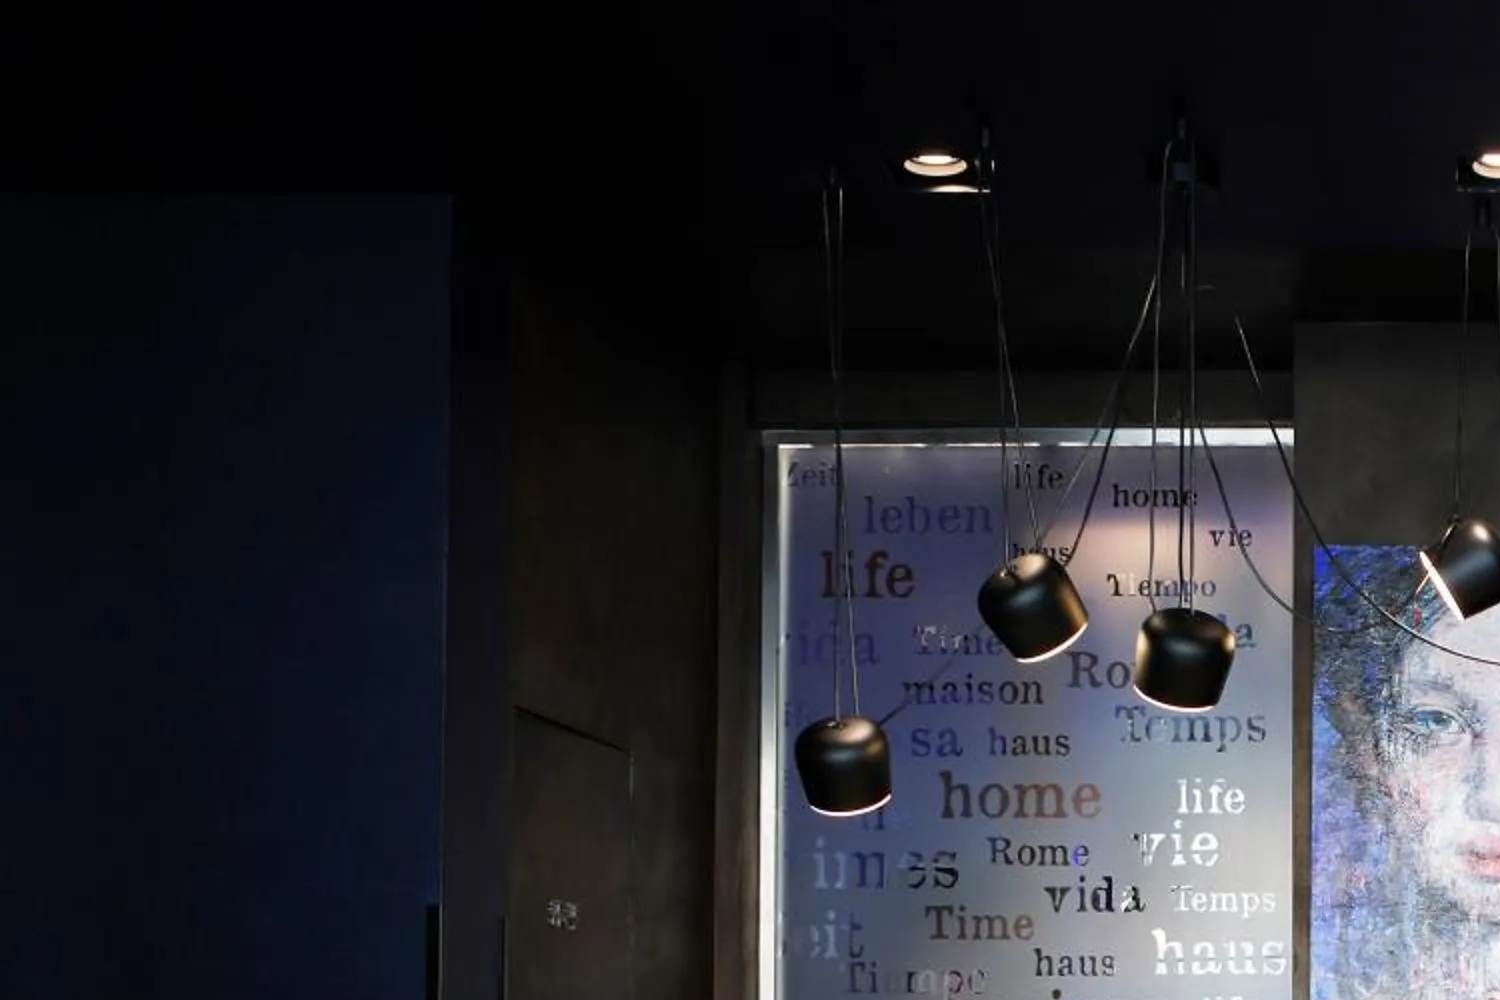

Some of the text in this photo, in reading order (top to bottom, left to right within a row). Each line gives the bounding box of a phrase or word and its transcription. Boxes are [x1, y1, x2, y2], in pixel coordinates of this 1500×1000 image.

[1014, 464, 1064, 490] life
[1112, 484, 1198, 508] home
[864, 496, 994, 534] leben
[1208, 528, 1253, 548] vie
[820, 549, 916, 599] life
[1066, 651, 1131, 689] Ro
[901, 672, 1045, 705] maison
[988, 726, 1072, 757] haus
[1115, 706, 1267, 753] Temps
[939, 770, 1103, 820] home
[1177, 778, 1247, 815] life
[987, 837, 1090, 867] Rome
[1131, 819, 1219, 867] vie
[1045, 875, 1147, 913] vida
[1170, 885, 1277, 918] Temps
[925, 905, 1034, 941] Time
[1034, 948, 1117, 977] haus
[1152, 928, 1287, 975] haus
